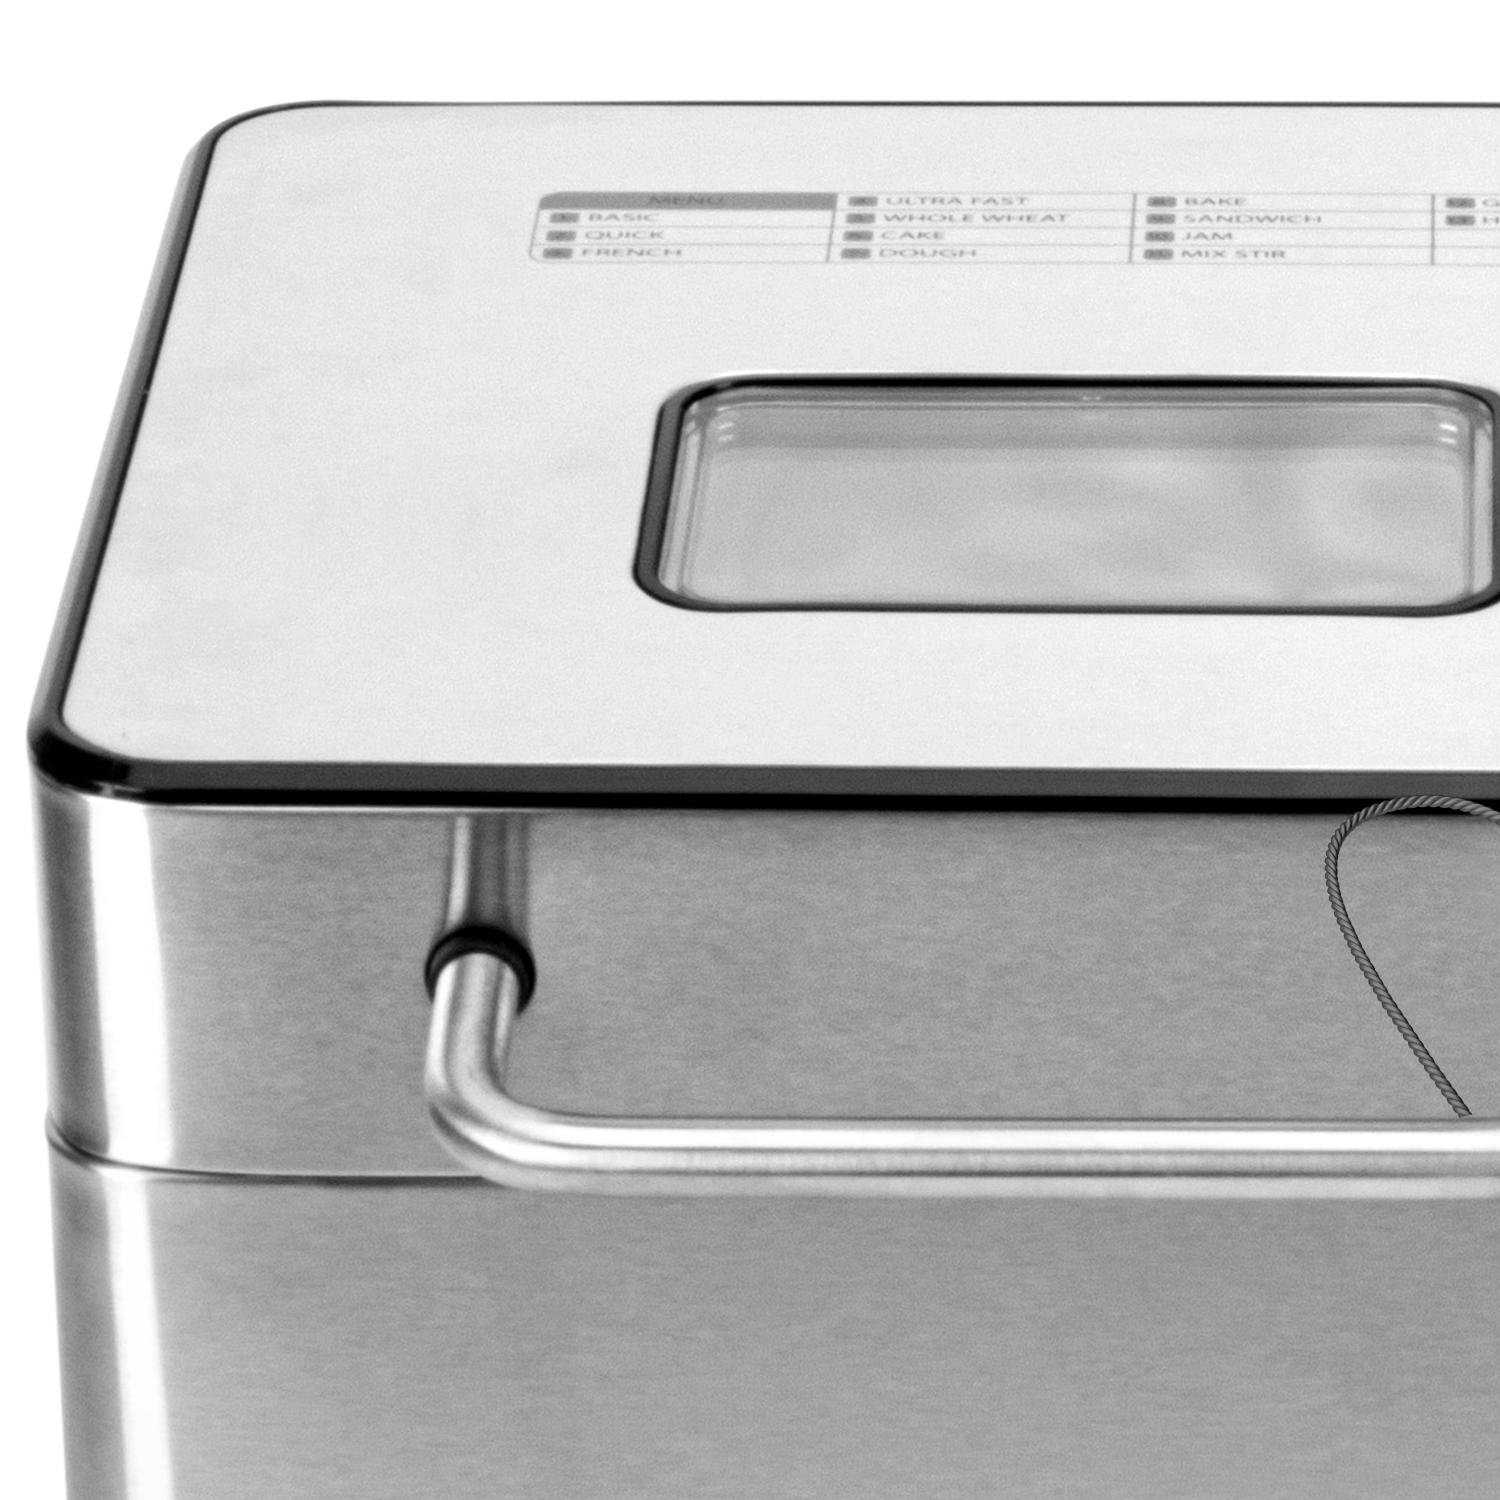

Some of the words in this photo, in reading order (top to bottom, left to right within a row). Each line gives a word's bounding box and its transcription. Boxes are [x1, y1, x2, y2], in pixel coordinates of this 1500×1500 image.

[649, 194, 726, 206] MENU
[885, 196, 964, 206] ULTRA
[970, 196, 1029, 206] FAST
[1183, 197, 1248, 207] BAKE
[587, 212, 660, 223] BASIC
[883, 213, 975, 223] WHOLE
[981, 213, 1068, 223] WHEAT
[1182, 214, 1323, 224] SANDWICH
[583, 230, 666, 241] QUICK
[880, 231, 946, 240] CAKE
[1181, 231, 1234, 241] JAM
[580, 248, 684, 258] FRENCH
[878, 248, 978, 258] DOUGH
[1180, 249, 1228, 259] MIX
[1235, 249, 1288, 259] STIR
